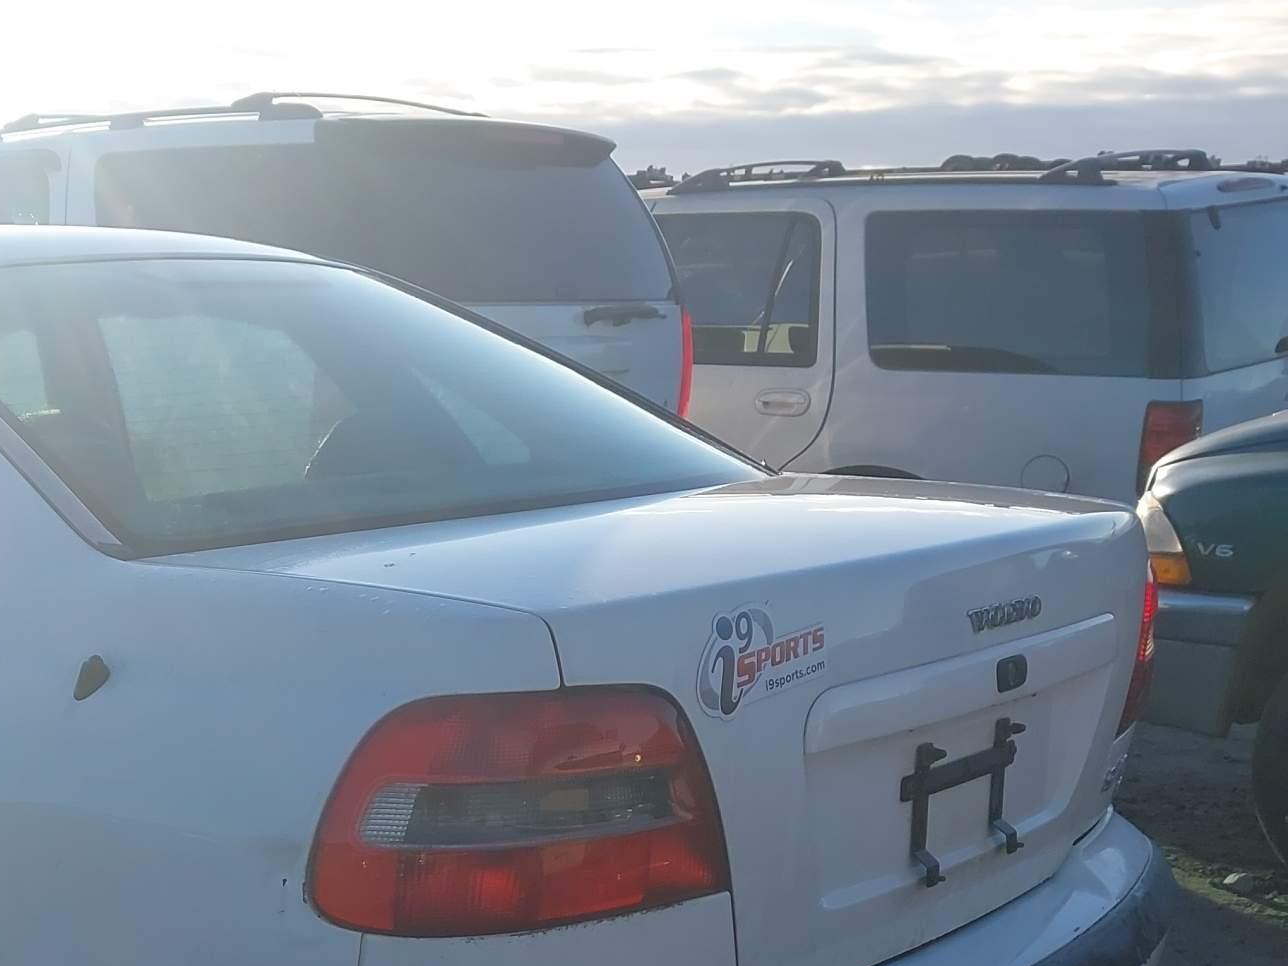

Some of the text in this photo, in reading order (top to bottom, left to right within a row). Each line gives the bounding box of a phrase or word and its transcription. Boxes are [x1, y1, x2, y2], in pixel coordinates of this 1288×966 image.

[1196, 542, 1235, 558] V6
[968, 595, 1041, 632] VOLVO
[737, 627, 825, 688] SPORTS
[765, 661, 825, 691] i9sports.com
